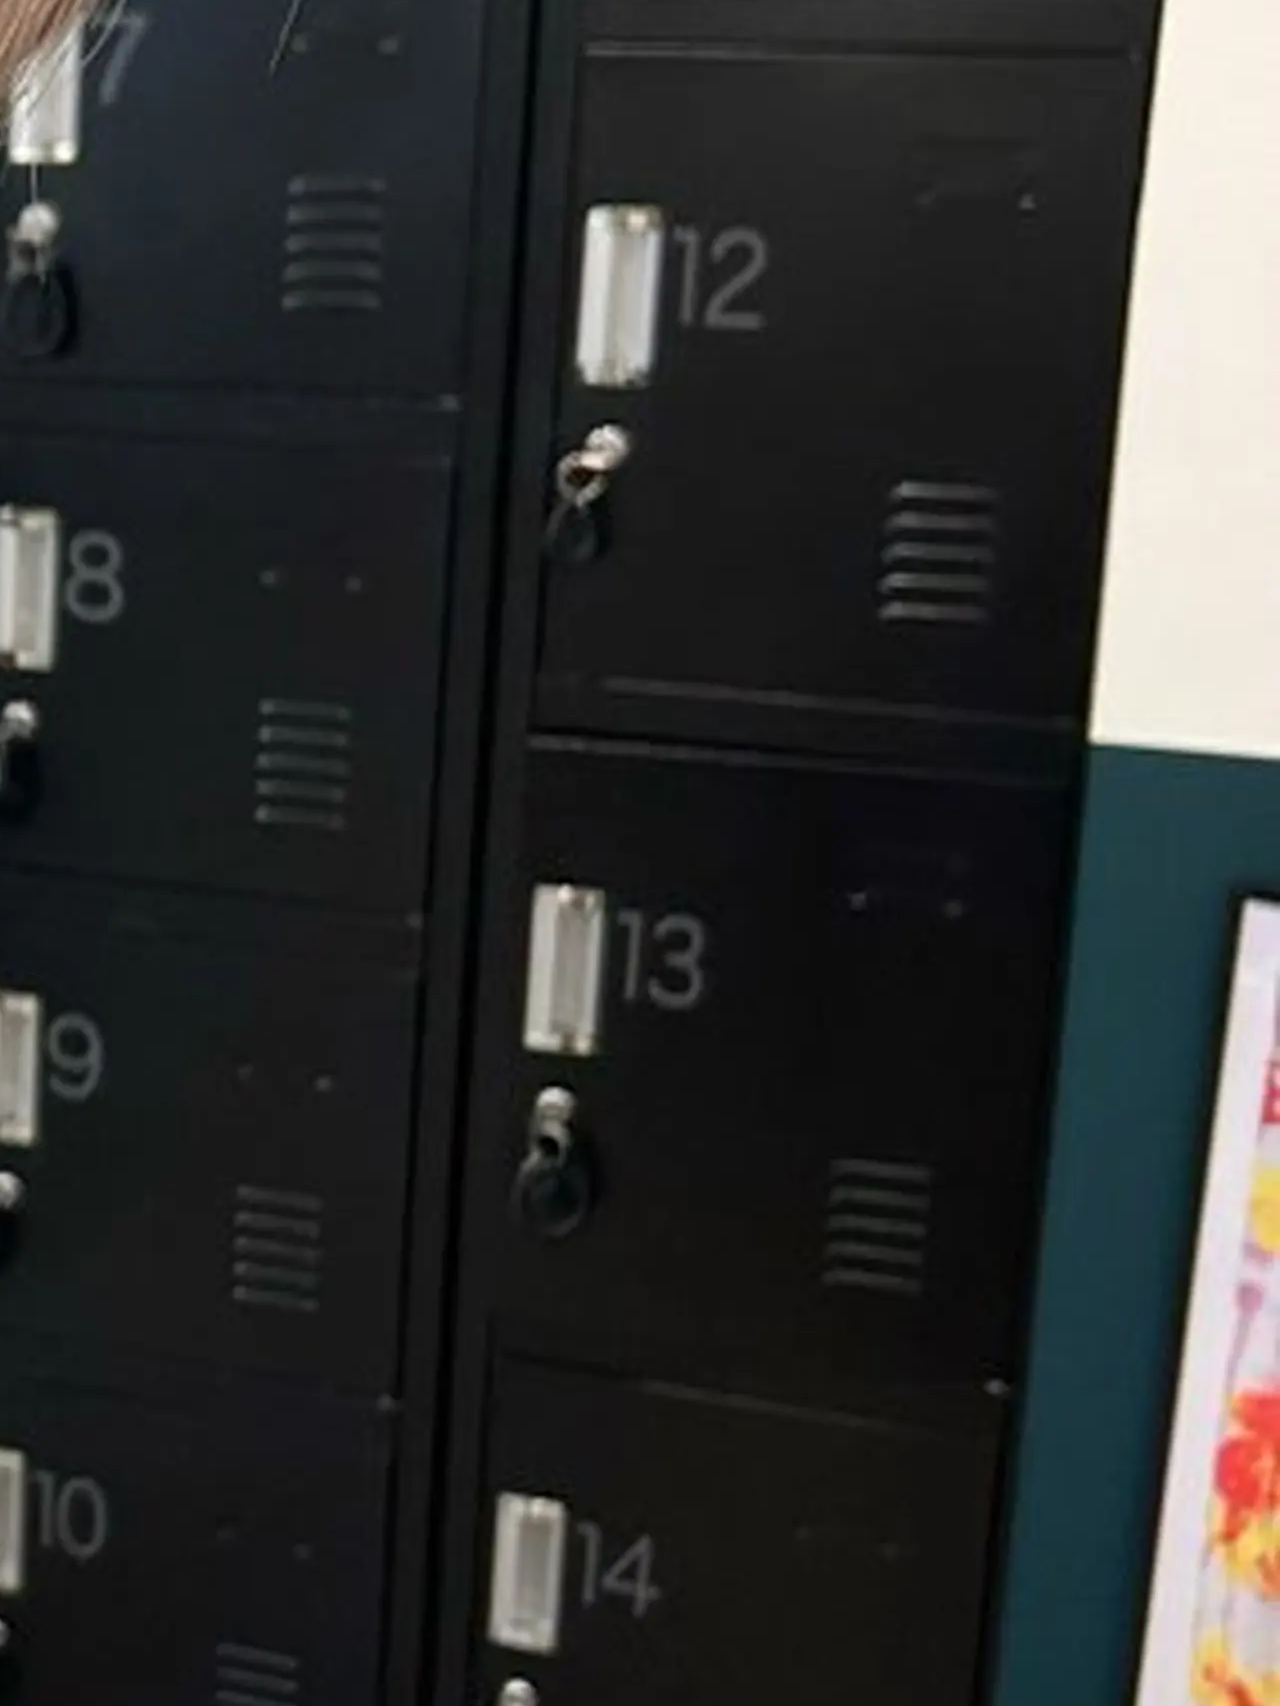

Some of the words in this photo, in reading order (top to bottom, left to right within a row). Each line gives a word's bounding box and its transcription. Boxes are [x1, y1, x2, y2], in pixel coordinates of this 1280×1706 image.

[94, 12, 147, 107] 7
[673, 225, 769, 330] 12
[65, 528, 126, 624] 8
[616, 910, 705, 1010] 13
[47, 1013, 104, 1103] 9
[36, 1469, 107, 1561] 10
[576, 1521, 662, 1619] 14
